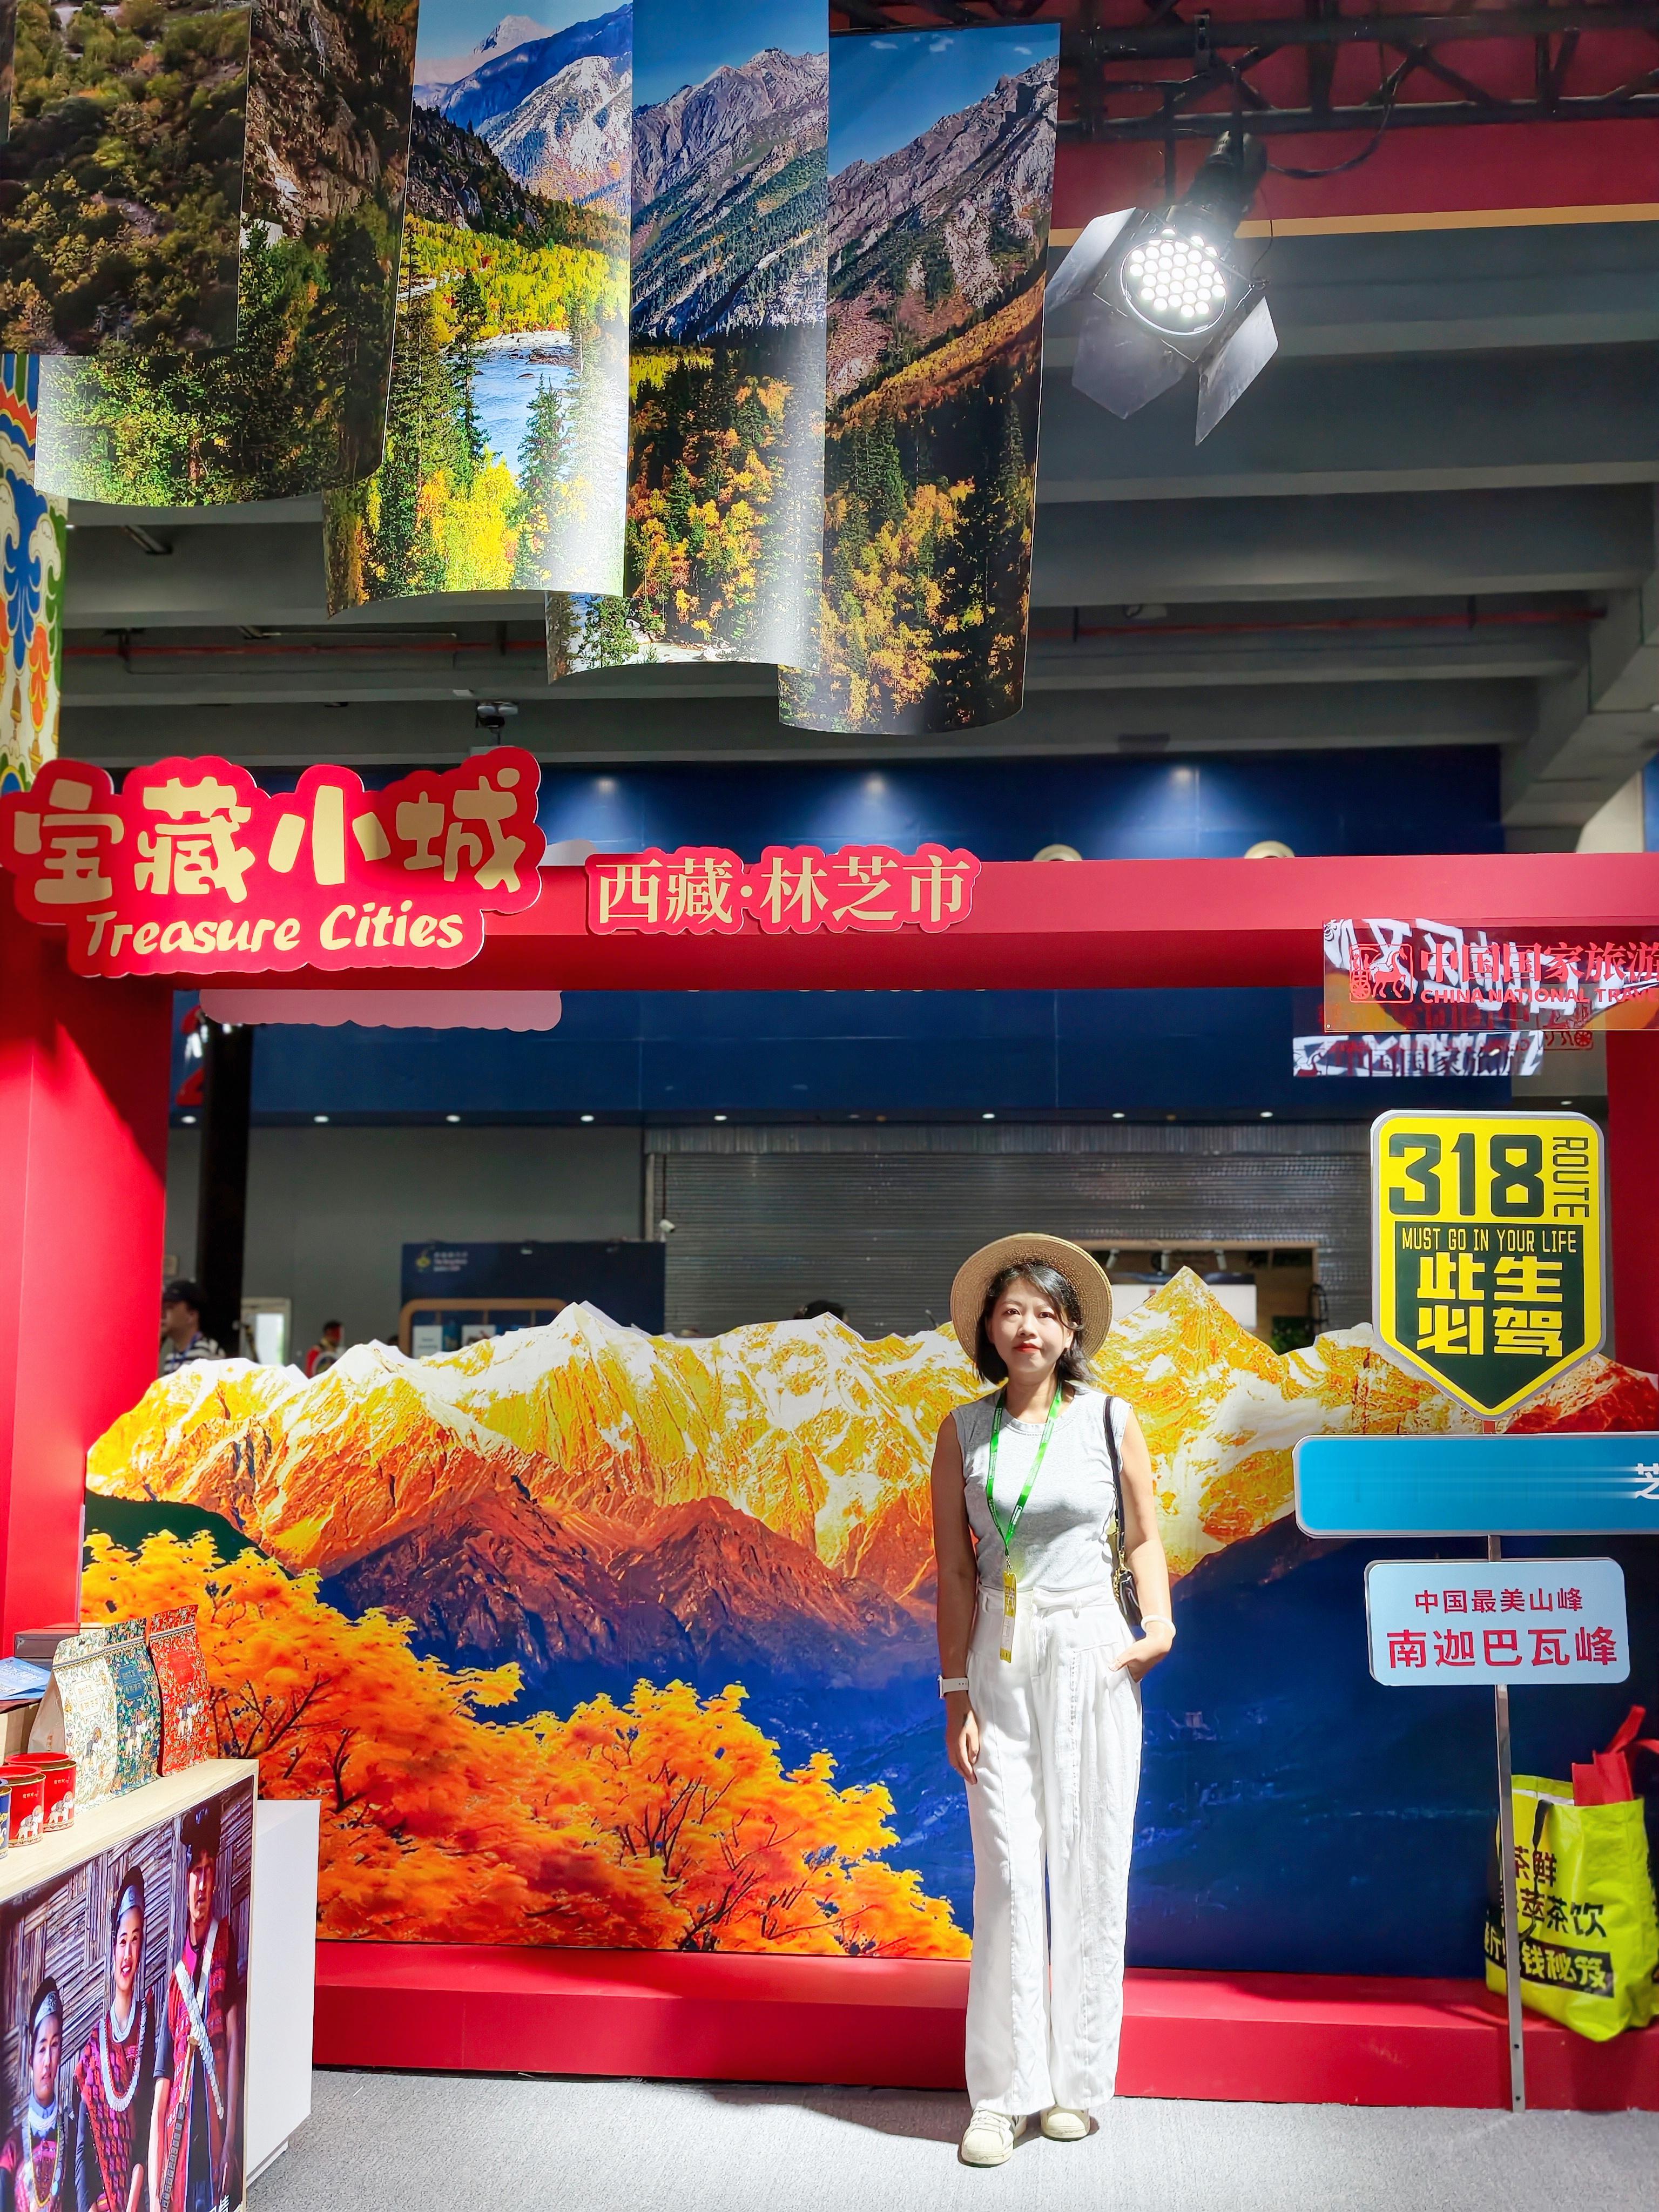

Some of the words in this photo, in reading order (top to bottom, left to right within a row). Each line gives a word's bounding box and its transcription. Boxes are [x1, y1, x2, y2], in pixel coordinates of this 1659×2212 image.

[14, 767, 526, 903] 宝藏小城
[596, 855, 971, 924] 西藏·林芝市
[86, 911, 300, 956] Treasure
[320, 900, 463, 950] Cities
[1421, 989, 1483, 1003] CHINA
[1489, 989, 1590, 1003] NATIONAL
[1389, 1132, 1544, 1218] 318
[1553, 1136, 1589, 1218] ROUTE
[1402, 1227, 1441, 1250] MUST
[1448, 1228, 1466, 1251] GO
[1473, 1229, 1488, 1252] IN
[1496, 1229, 1535, 1252] YOUR
[1542, 1230, 1576, 1253] LIFE
[1417, 1252, 1563, 1303] 此生
[1417, 1305, 1563, 1357] 必驾
[1414, 1588, 1583, 1614] 中国最美山峰
[1386, 1626, 1617, 1668] 南迦巴瓦峰
